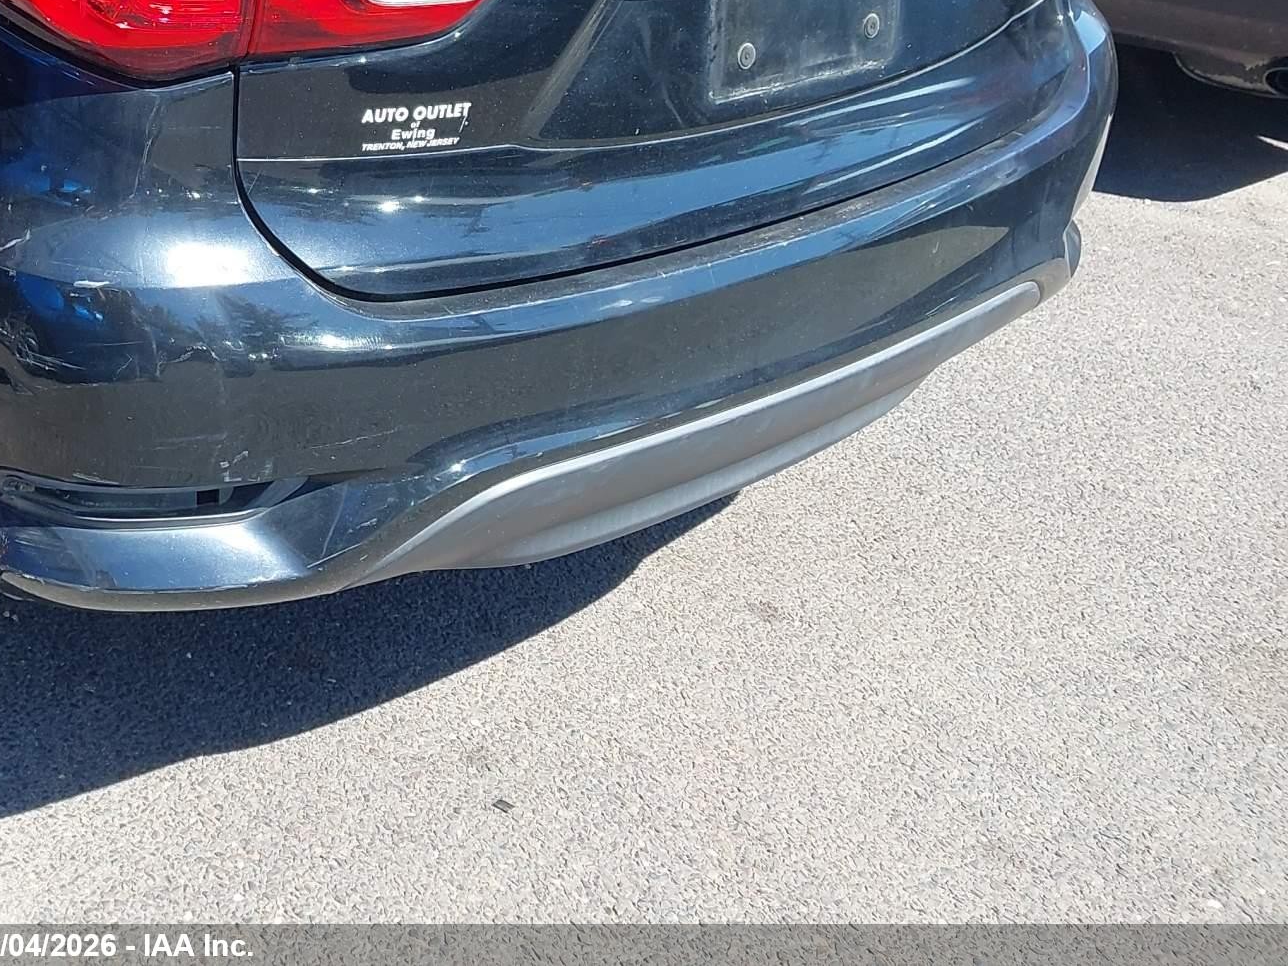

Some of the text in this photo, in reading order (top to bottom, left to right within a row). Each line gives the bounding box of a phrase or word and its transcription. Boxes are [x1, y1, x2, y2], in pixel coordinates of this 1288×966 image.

[361, 102, 472, 124] AUTO OUTLET
[411, 121, 420, 129] of
[391, 128, 436, 141] Ewing
[361, 137, 460, 151] TRENTON, NEW JERSEY
